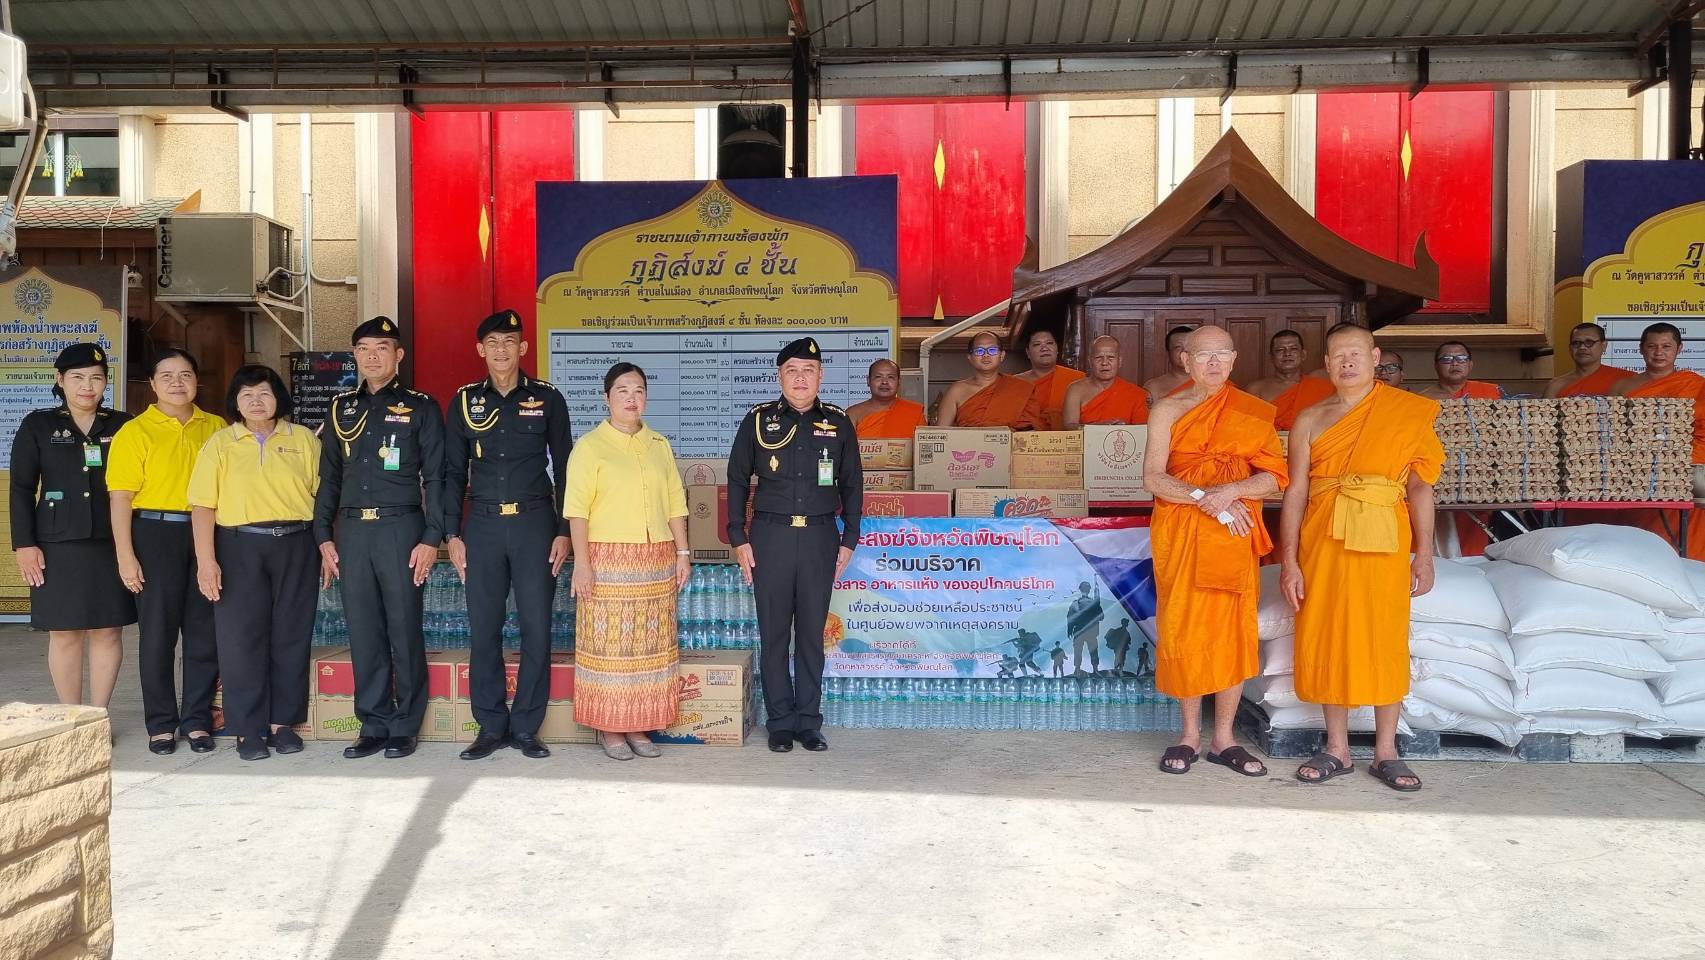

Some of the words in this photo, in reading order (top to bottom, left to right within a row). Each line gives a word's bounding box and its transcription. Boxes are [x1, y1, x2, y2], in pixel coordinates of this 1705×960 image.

[158, 229, 172, 289] Carrier
[734, 255, 751, 276] ๔
[760, 242, 798, 276] ชั้น
[1625, 269, 1685, 284] วัดคูหาสวรรค์
[562, 287, 572, 297] ณ
[574, 283, 630, 301] วัดคูหาสวรรค์
[754, 312, 783, 325] ห้องละ
[830, 314, 849, 325] บาท
[684, 337, 713, 350] จำนวนเงิน
[853, 335, 884, 347] จำนวนเงิน
[876, 552, 981, 572] ร่วมบริจาค
[870, 577, 939, 591] อาหารแห้ง
[848, 599, 1022, 614] เพื่อส่งมอบช่วยเหลือประชาชน
[847, 618, 1020, 634] ในศูนย์อพยพจากเหตุสงคราม
[335, 722, 362, 733] FLAVO
